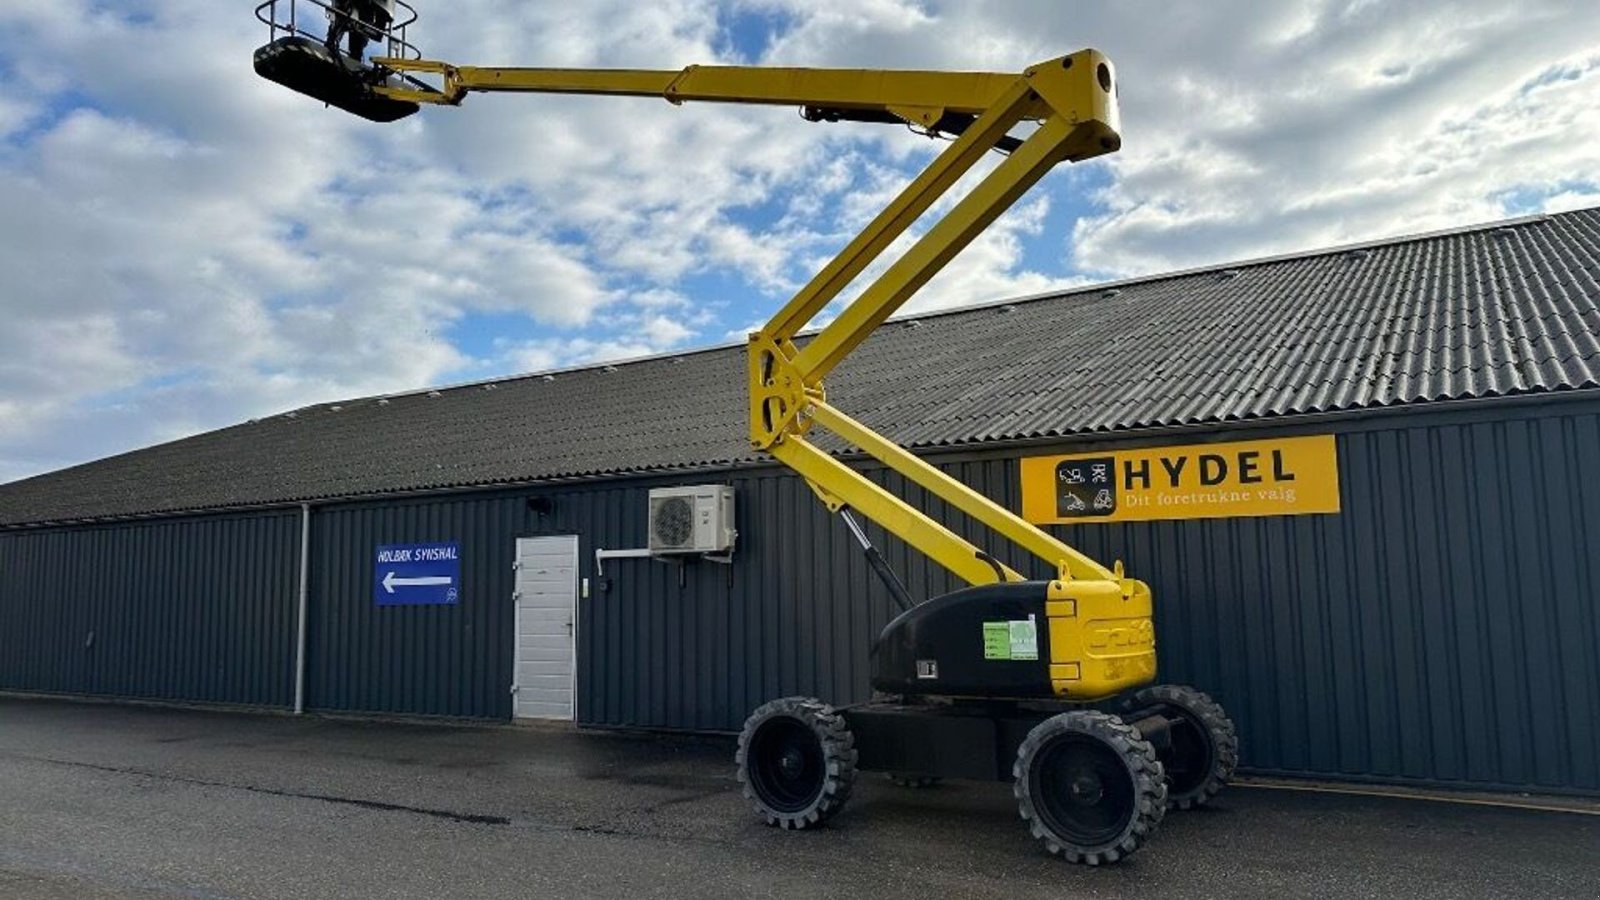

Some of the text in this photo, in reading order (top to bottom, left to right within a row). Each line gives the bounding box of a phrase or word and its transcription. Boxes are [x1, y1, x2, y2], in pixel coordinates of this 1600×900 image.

[1124, 450, 1295, 490] HYDEL
[1126, 487, 1297, 507] Dit foretrukne valg
